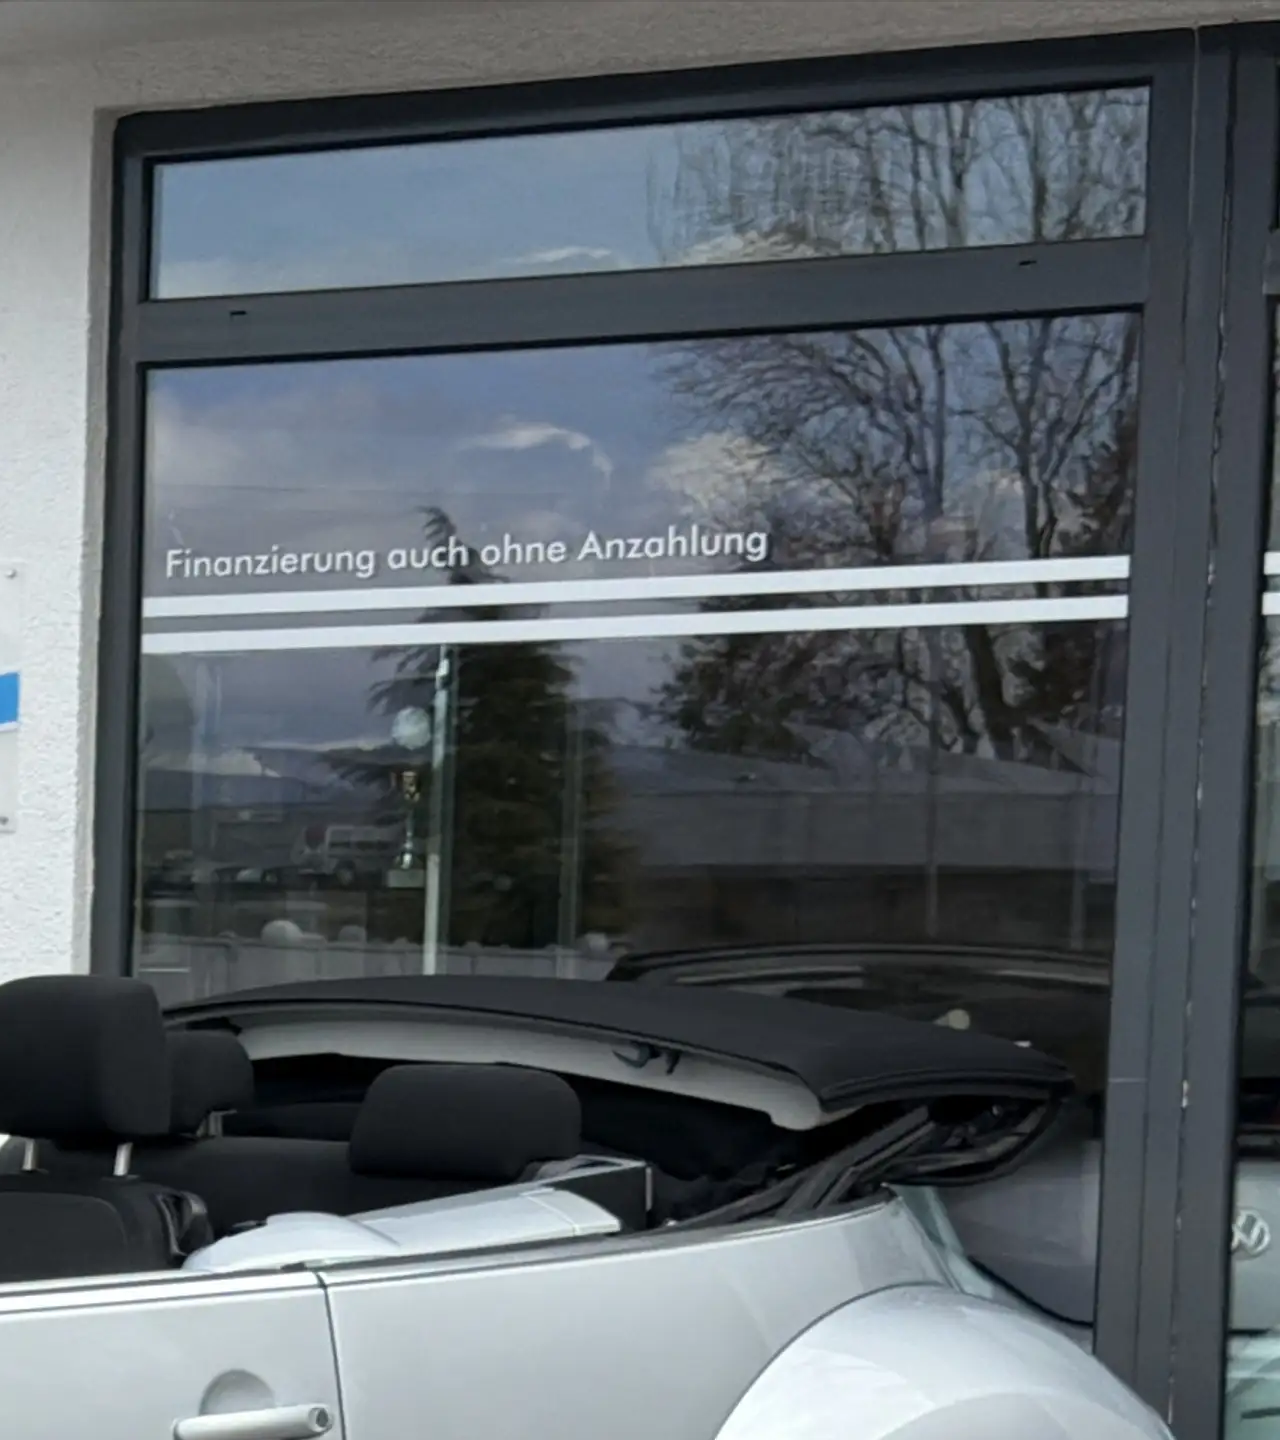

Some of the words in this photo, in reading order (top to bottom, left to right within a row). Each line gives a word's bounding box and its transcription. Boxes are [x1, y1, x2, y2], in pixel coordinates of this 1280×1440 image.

[165, 544, 375, 579] Finanzierung
[387, 535, 469, 570] auch
[480, 532, 567, 565] ohne
[577, 523, 769, 562] Anzahlung
